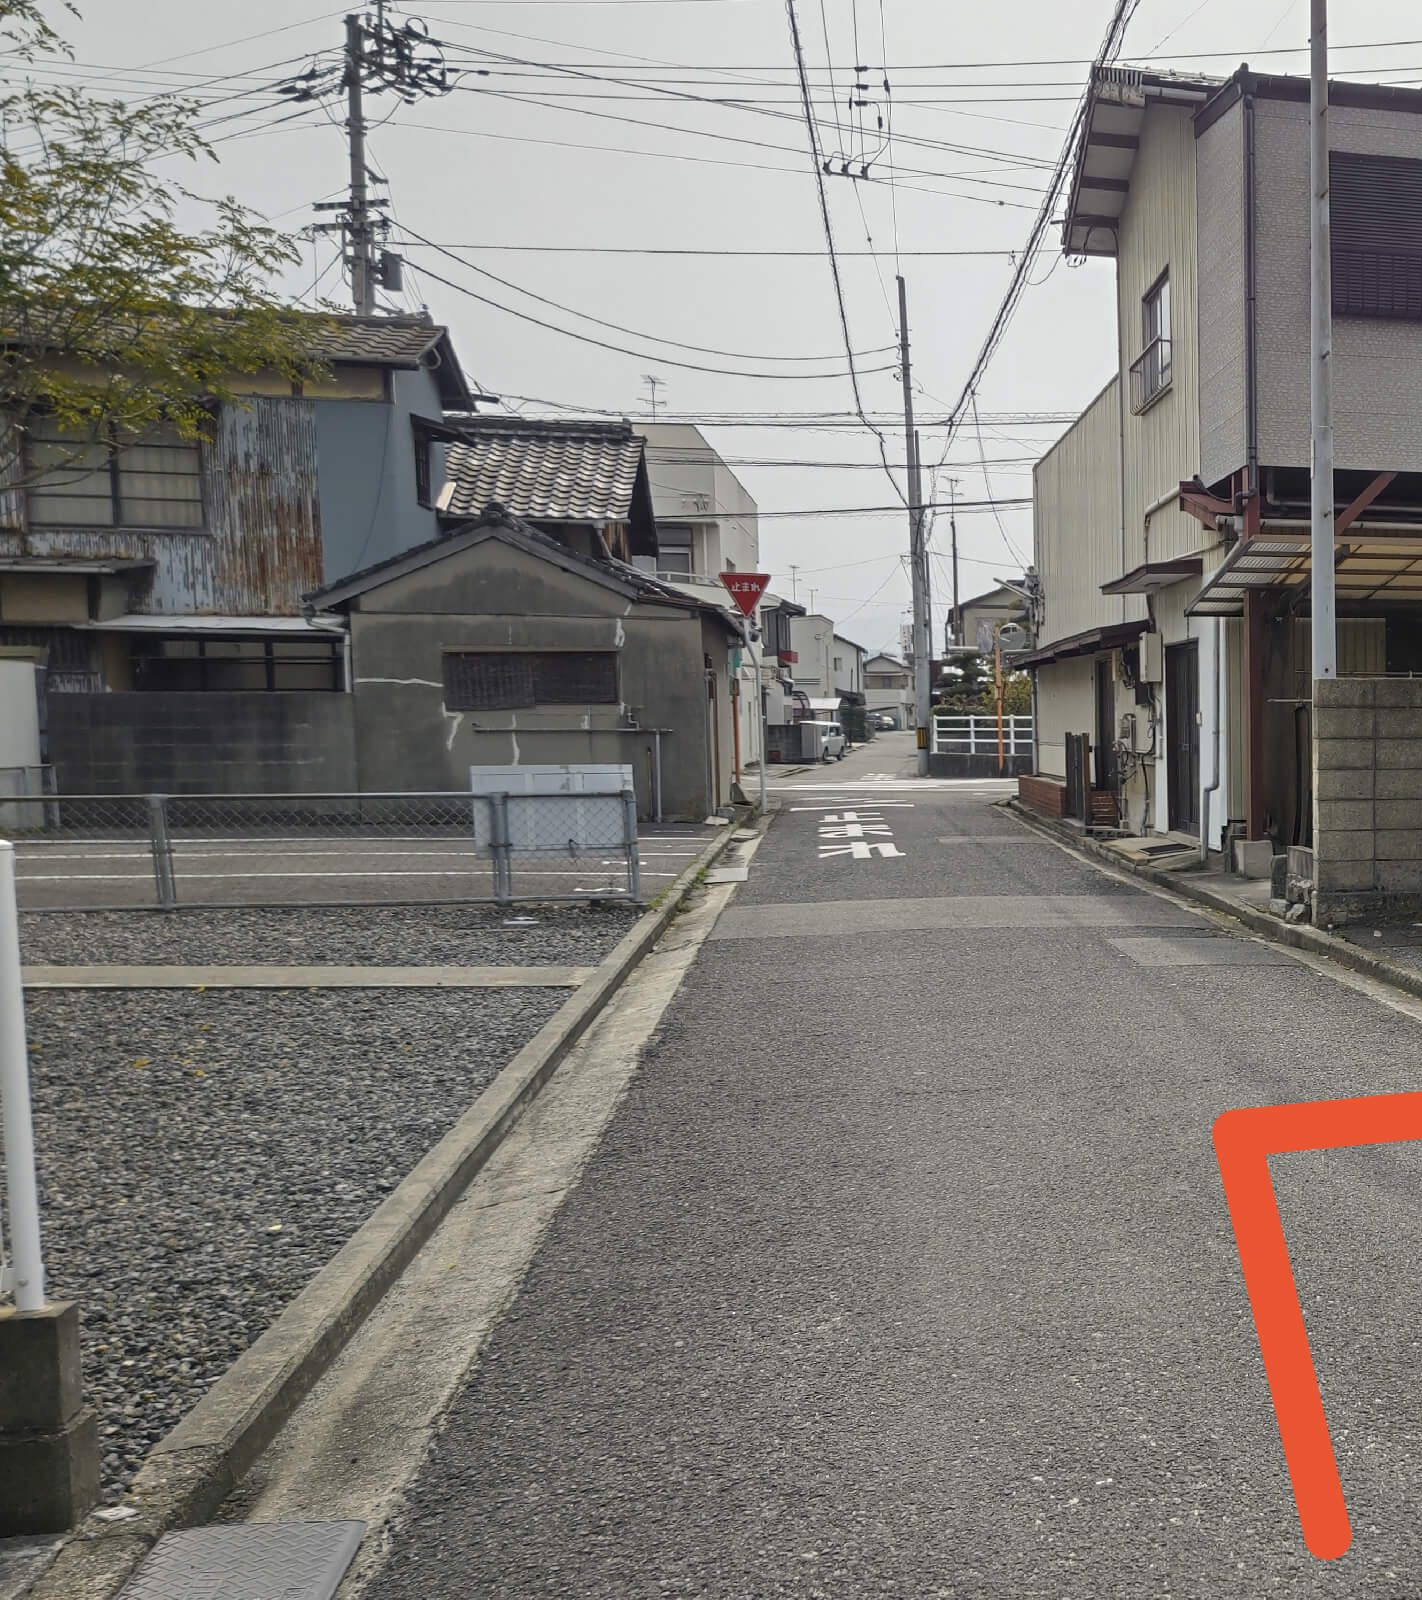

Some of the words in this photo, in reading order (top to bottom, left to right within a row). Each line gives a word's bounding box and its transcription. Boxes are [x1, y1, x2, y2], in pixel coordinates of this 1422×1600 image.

[731, 581, 760, 592] 止まれ
[818, 812, 906, 859] 止まれ
